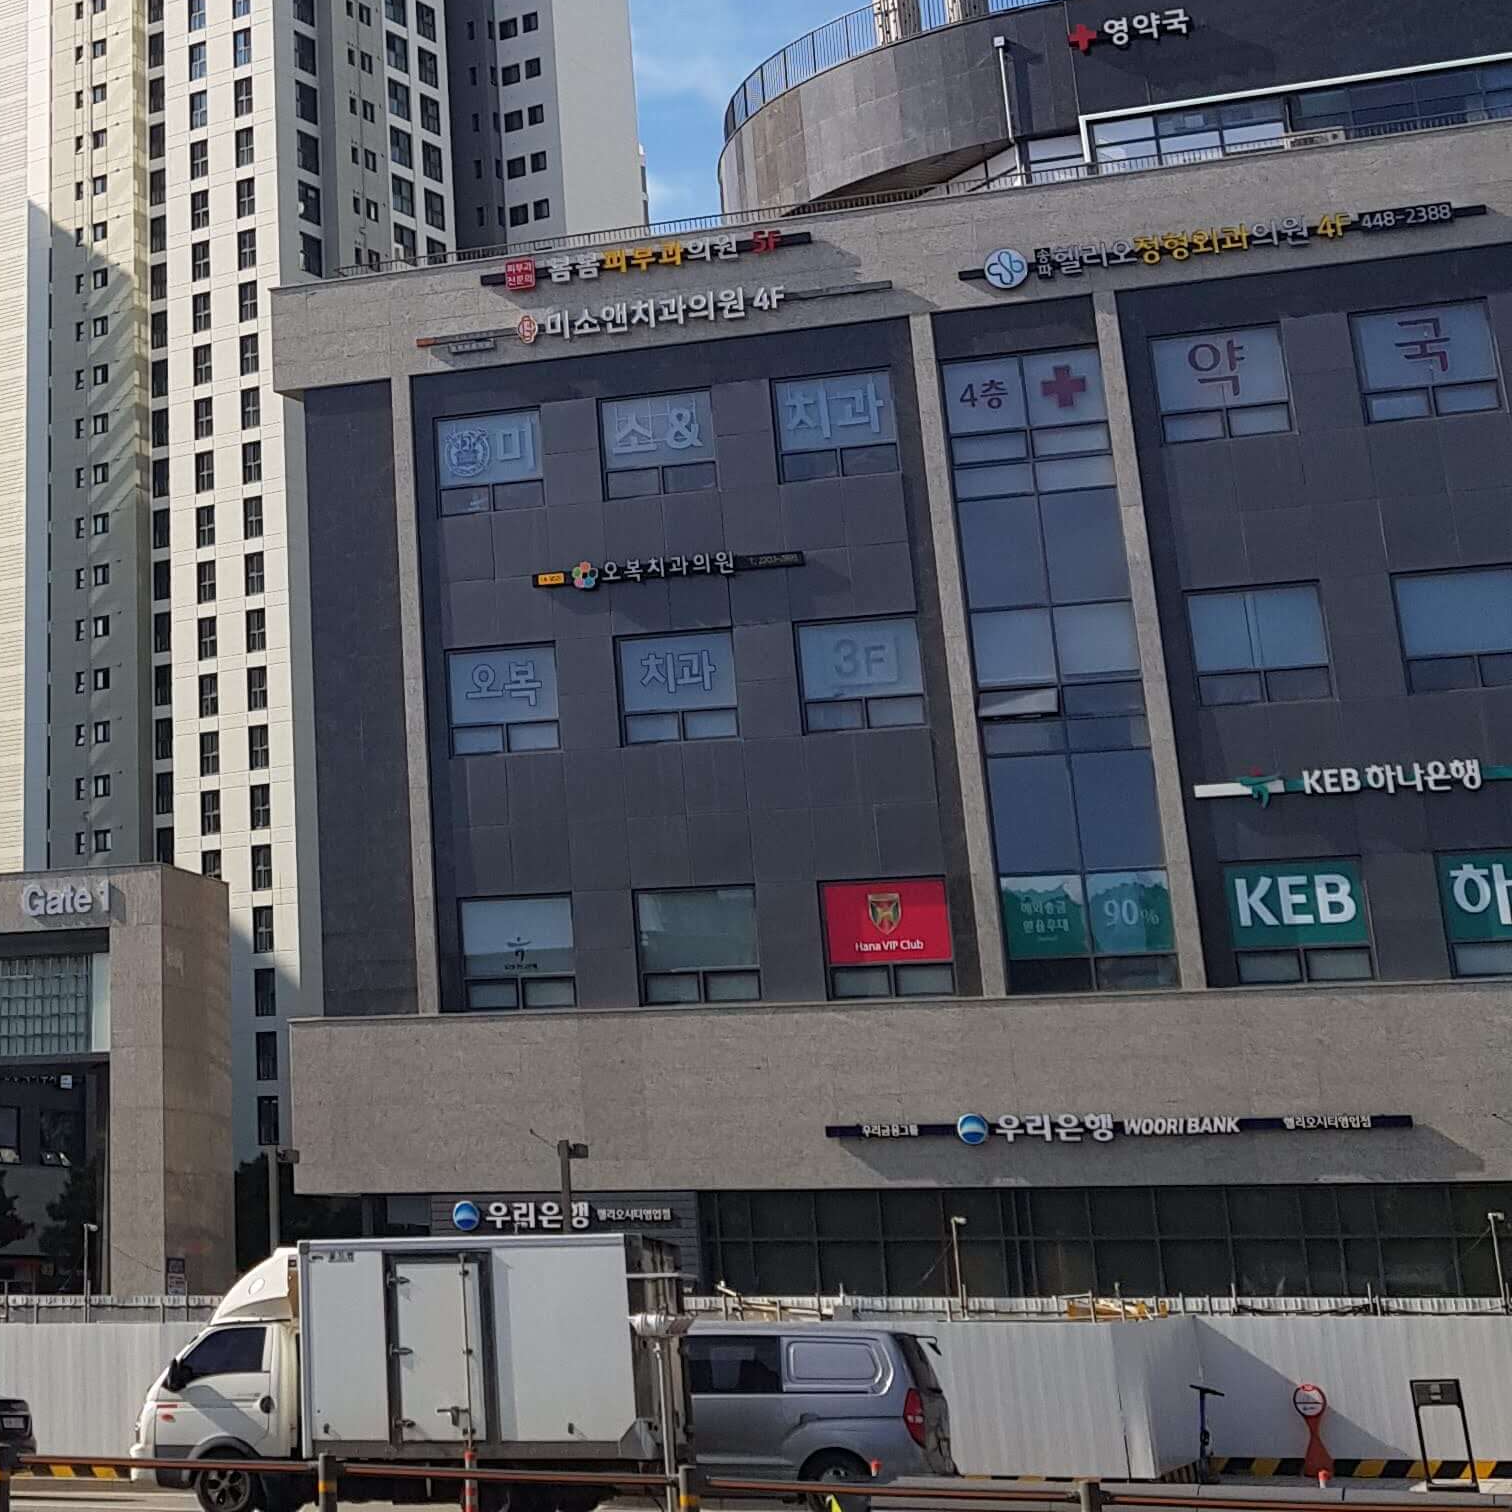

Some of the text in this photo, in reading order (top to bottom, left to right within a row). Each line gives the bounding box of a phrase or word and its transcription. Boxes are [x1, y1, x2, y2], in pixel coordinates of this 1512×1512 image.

[1103, 8, 1190, 46] 영약국
[752, 230, 783, 254] 5F
[1054, 215, 1311, 275] 헬리오정형외과의원
[1316, 213, 1354, 238] 4F
[1361, 204, 1452, 229] 448-2388
[545, 287, 785, 340] 미소앤치과의원 4F
[1188, 317, 1451, 397] 약 국
[959, 379, 1008, 410] 4층
[495, 417, 536, 466] 미
[785, 381, 885, 439] 치과
[602, 550, 735, 583] 오복치과의원
[465, 637, 887, 707] 오복 치과 3F
[1302, 758, 1482, 794] KEB 하나은행
[23, 879, 110, 917] Gate 1
[1103, 898, 1160, 927] 90%
[1234, 874, 1358, 927] KEB
[855, 939, 924, 952] Hana VIP Club
[995, 1112, 1115, 1143] 우리은행
[1123, 1118, 1184, 1136] WOORI
[1187, 1115, 1241, 1134] BANK
[486, 1201, 590, 1230] 우리은행
